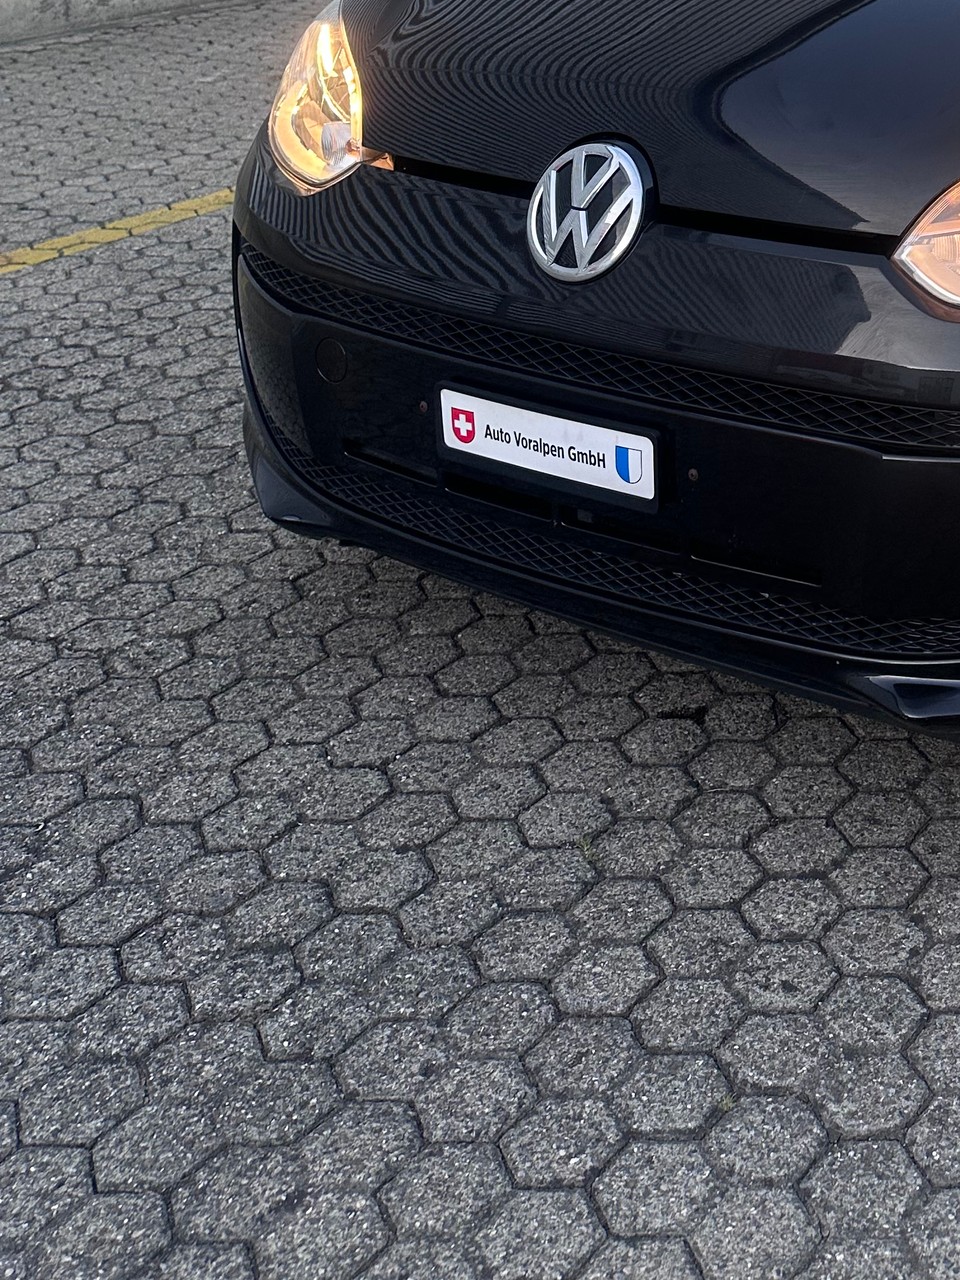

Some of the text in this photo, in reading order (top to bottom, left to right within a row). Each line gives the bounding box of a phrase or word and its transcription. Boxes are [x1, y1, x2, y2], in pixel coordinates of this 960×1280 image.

[527, 143, 643, 282] VW
[485, 424, 606, 468] Auto Voralpen GmbH
